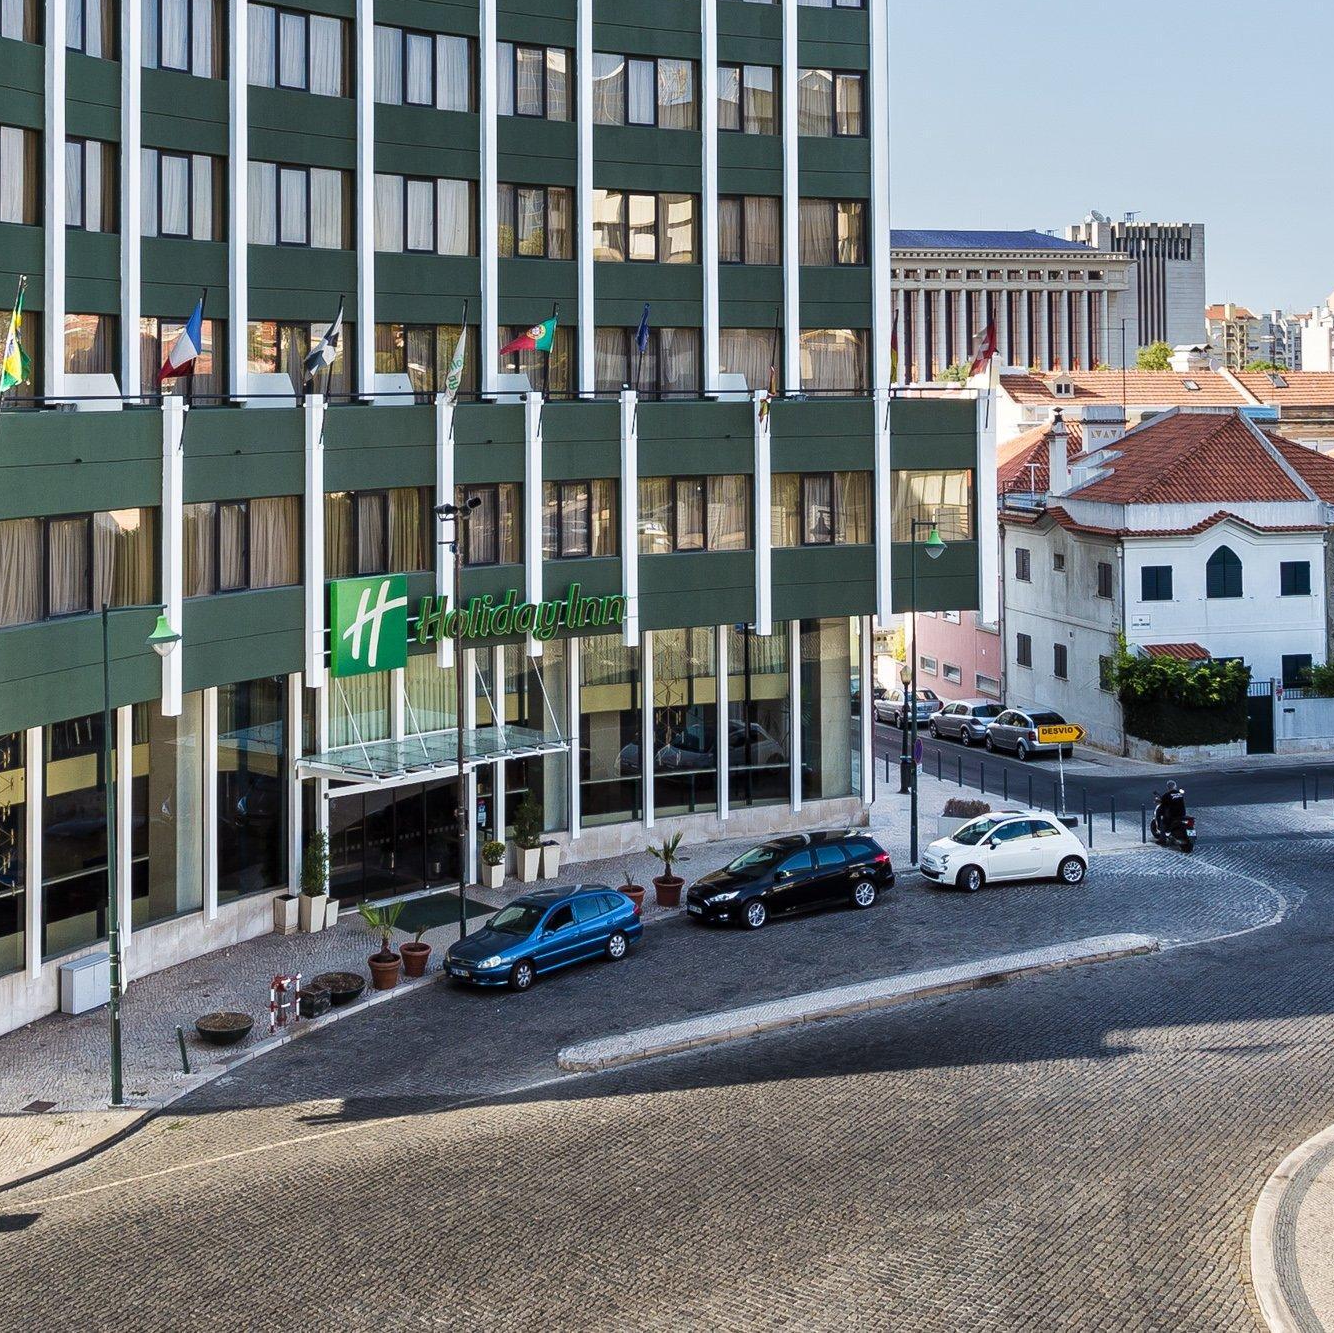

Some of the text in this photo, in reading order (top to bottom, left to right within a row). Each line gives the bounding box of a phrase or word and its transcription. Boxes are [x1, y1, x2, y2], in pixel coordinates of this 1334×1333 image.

[417, 583, 628, 643] Holiday Inn
[1041, 726, 1074, 735] DESVIO
